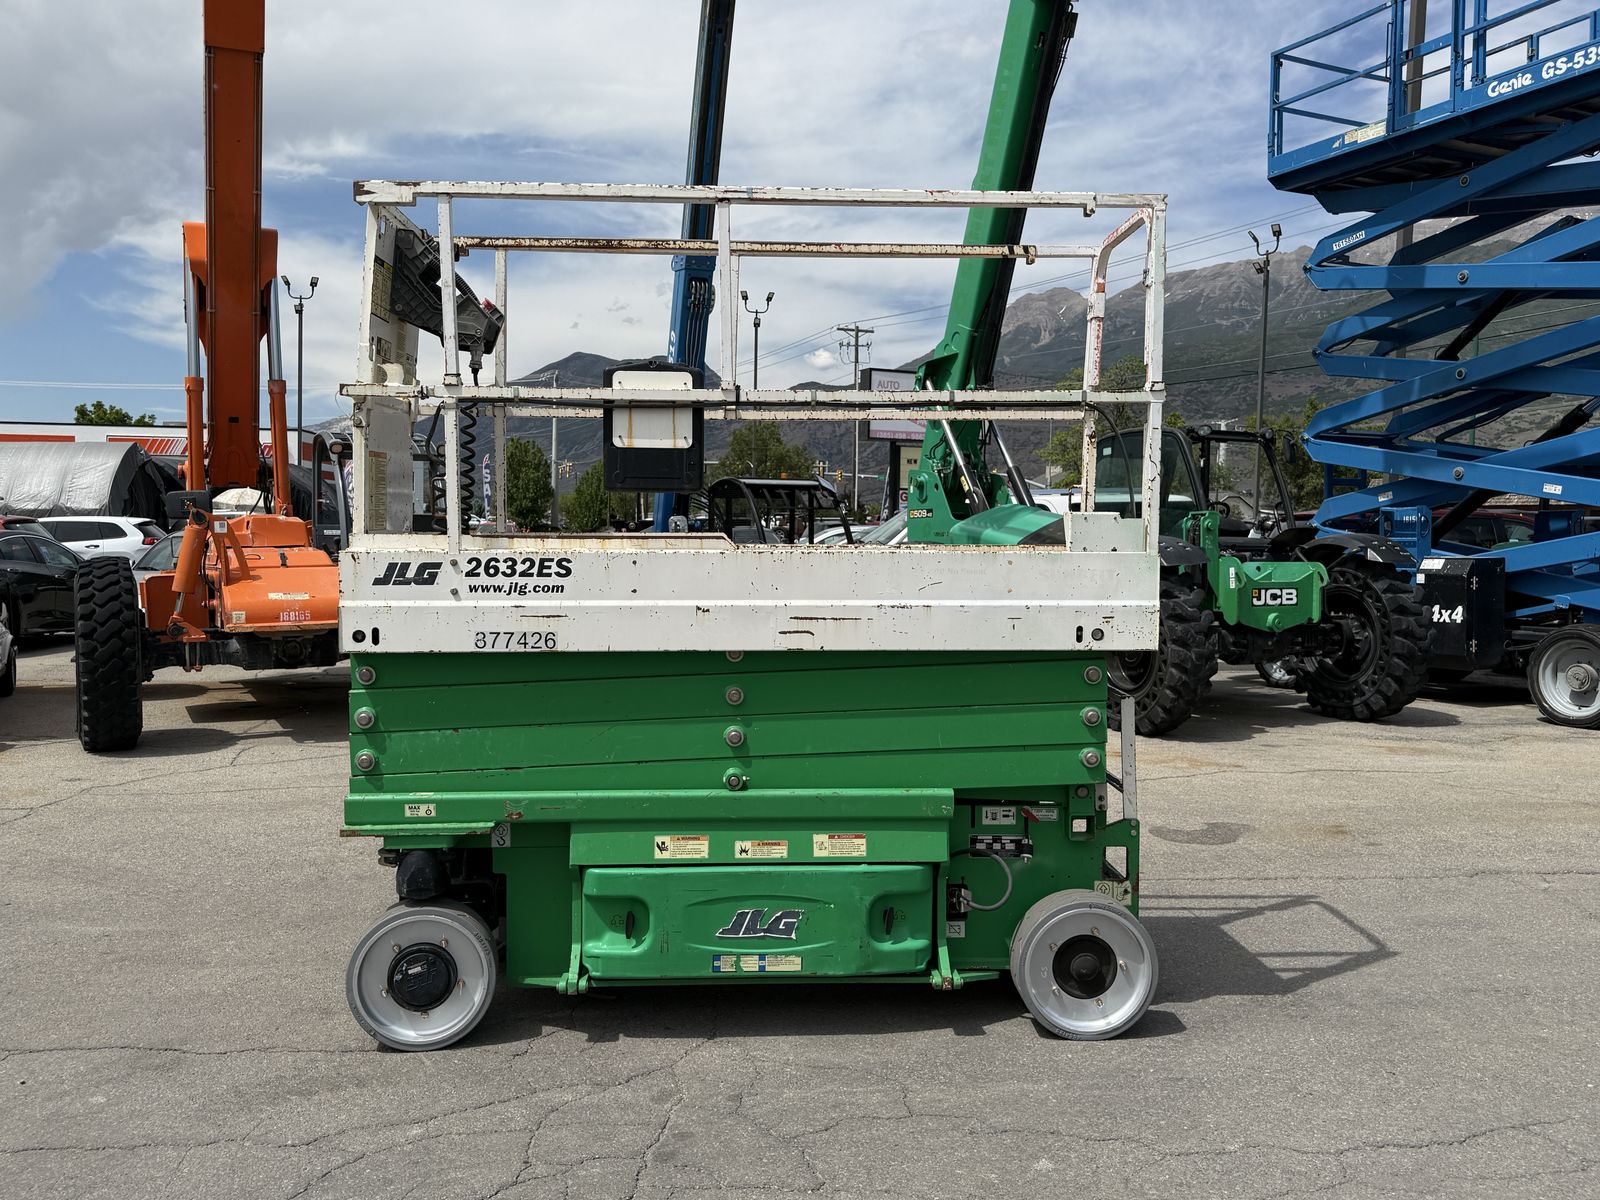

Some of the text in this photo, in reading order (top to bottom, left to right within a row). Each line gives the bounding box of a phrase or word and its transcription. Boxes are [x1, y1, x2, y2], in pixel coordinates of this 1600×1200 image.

[1487, 72, 1533, 97] Genie
[877, 380, 900, 390] AUTO
[372, 562, 443, 586] JLG
[464, 557, 573, 578] 2632ES
[468, 582, 565, 596] www.jlg.com
[1252, 588, 1298, 606] JCB
[474, 631, 557, 650] 377426
[715, 908, 804, 940] JLG
